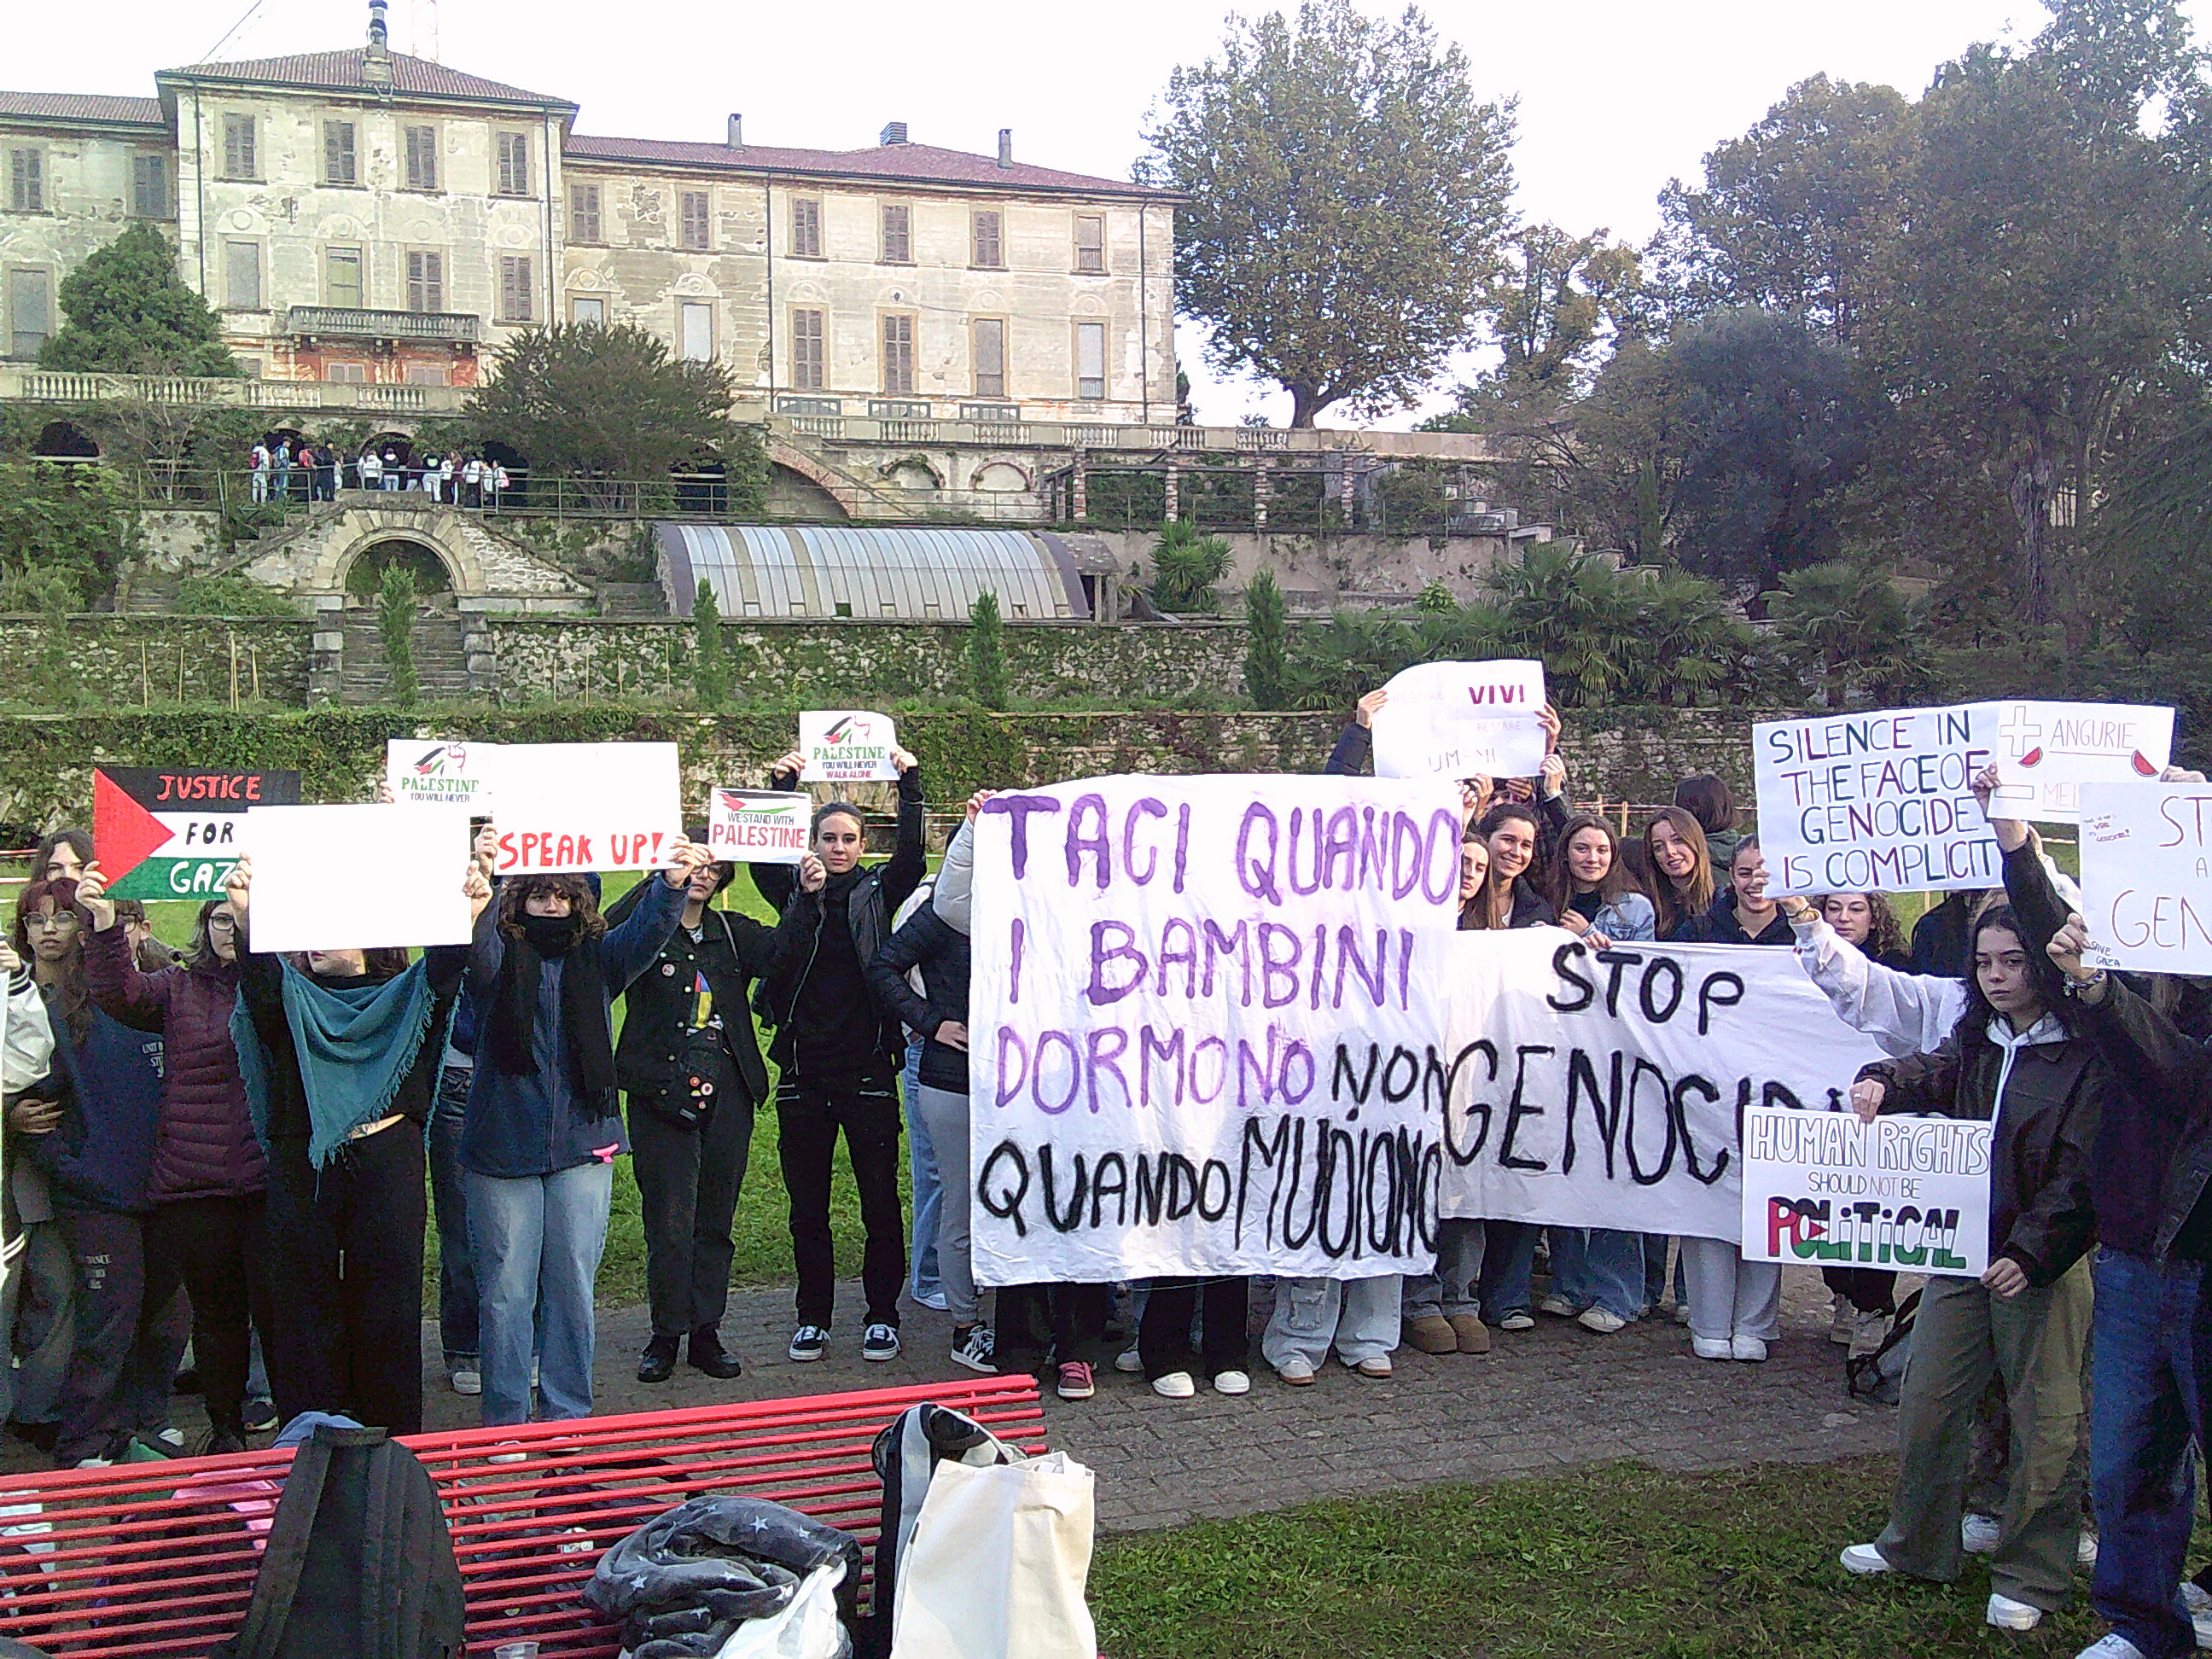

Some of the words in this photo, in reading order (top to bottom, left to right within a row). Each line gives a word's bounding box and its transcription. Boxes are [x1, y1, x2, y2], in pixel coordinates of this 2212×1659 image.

[1468, 684, 1525, 705] VIVI
[1769, 715, 1916, 765] SILENCE
[1936, 709, 1970, 746] IN
[2049, 718, 2138, 749] ANGURIE
[812, 746, 885, 760] PALESTINE
[822, 760, 835, 770] YOU
[836, 760, 853, 770] WILL
[853, 760, 877, 769] NEVER
[401, 777, 480, 793] PALESTINE
[826, 770, 848, 778] WALK
[849, 770, 873, 778] ALONE
[1781, 762, 1853, 806] THE
[410, 792, 425, 801] YOU
[426, 793, 445, 802] WILL
[445, 794, 470, 803] NEVER
[2042, 782, 2080, 808] MEL
[185, 821, 235, 845] FOR
[727, 812, 742, 823] WE
[742, 812, 771, 824] STAND
[773, 815, 795, 826] WITH
[1801, 795, 1980, 844] GENOCIDE
[2159, 795, 2212, 847] ST
[498, 831, 593, 870] SPEAK
[610, 831, 665, 865] UP!
[712, 824, 806, 849] PALESTINE
[983, 792, 1191, 894] TACI
[1236, 800, 1462, 905] QUANDO
[170, 860, 237, 894] GAZ
[1783, 855, 1813, 890] IS
[1825, 838, 1998, 888] COMPLICIT
[1009, 917, 1025, 1004] I
[1085, 917, 1413, 1010] BAMBINI
[2091, 940, 2111, 957] SAVE
[1545, 942, 1745, 1036] STOP
[995, 1023, 1315, 1115] DORMONO
[1331, 1042, 1449, 1120] NON
[1446, 1039, 1842, 1185] GENOCI
[1749, 1115, 1867, 1167] HUMAN
[977, 1138, 1231, 1237] QUANDO
[1807, 1171, 1867, 1195] SHOULD
[1869, 1175, 1899, 1197] NOT
[1901, 1178, 1924, 1200] BE
